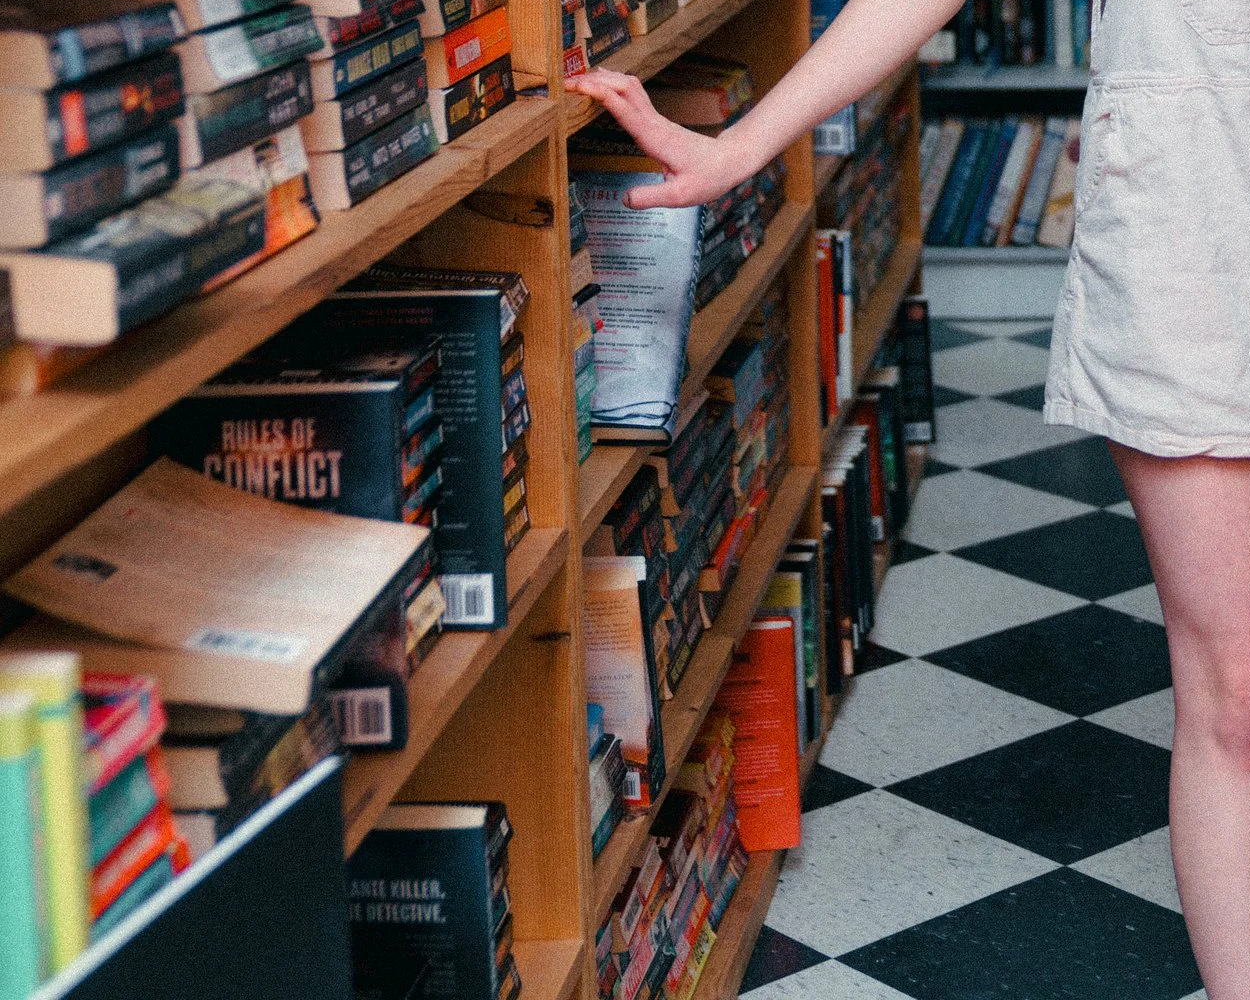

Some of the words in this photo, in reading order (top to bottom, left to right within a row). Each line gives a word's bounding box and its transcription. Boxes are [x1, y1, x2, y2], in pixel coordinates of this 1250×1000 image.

[372, 146, 389, 169] INTO
[387, 139, 402, 158] THE
[401, 125, 422, 149] WATER
[221, 419, 285, 451] RULES
[290, 417, 318, 450] OF
[203, 450, 343, 499] CONFLICT
